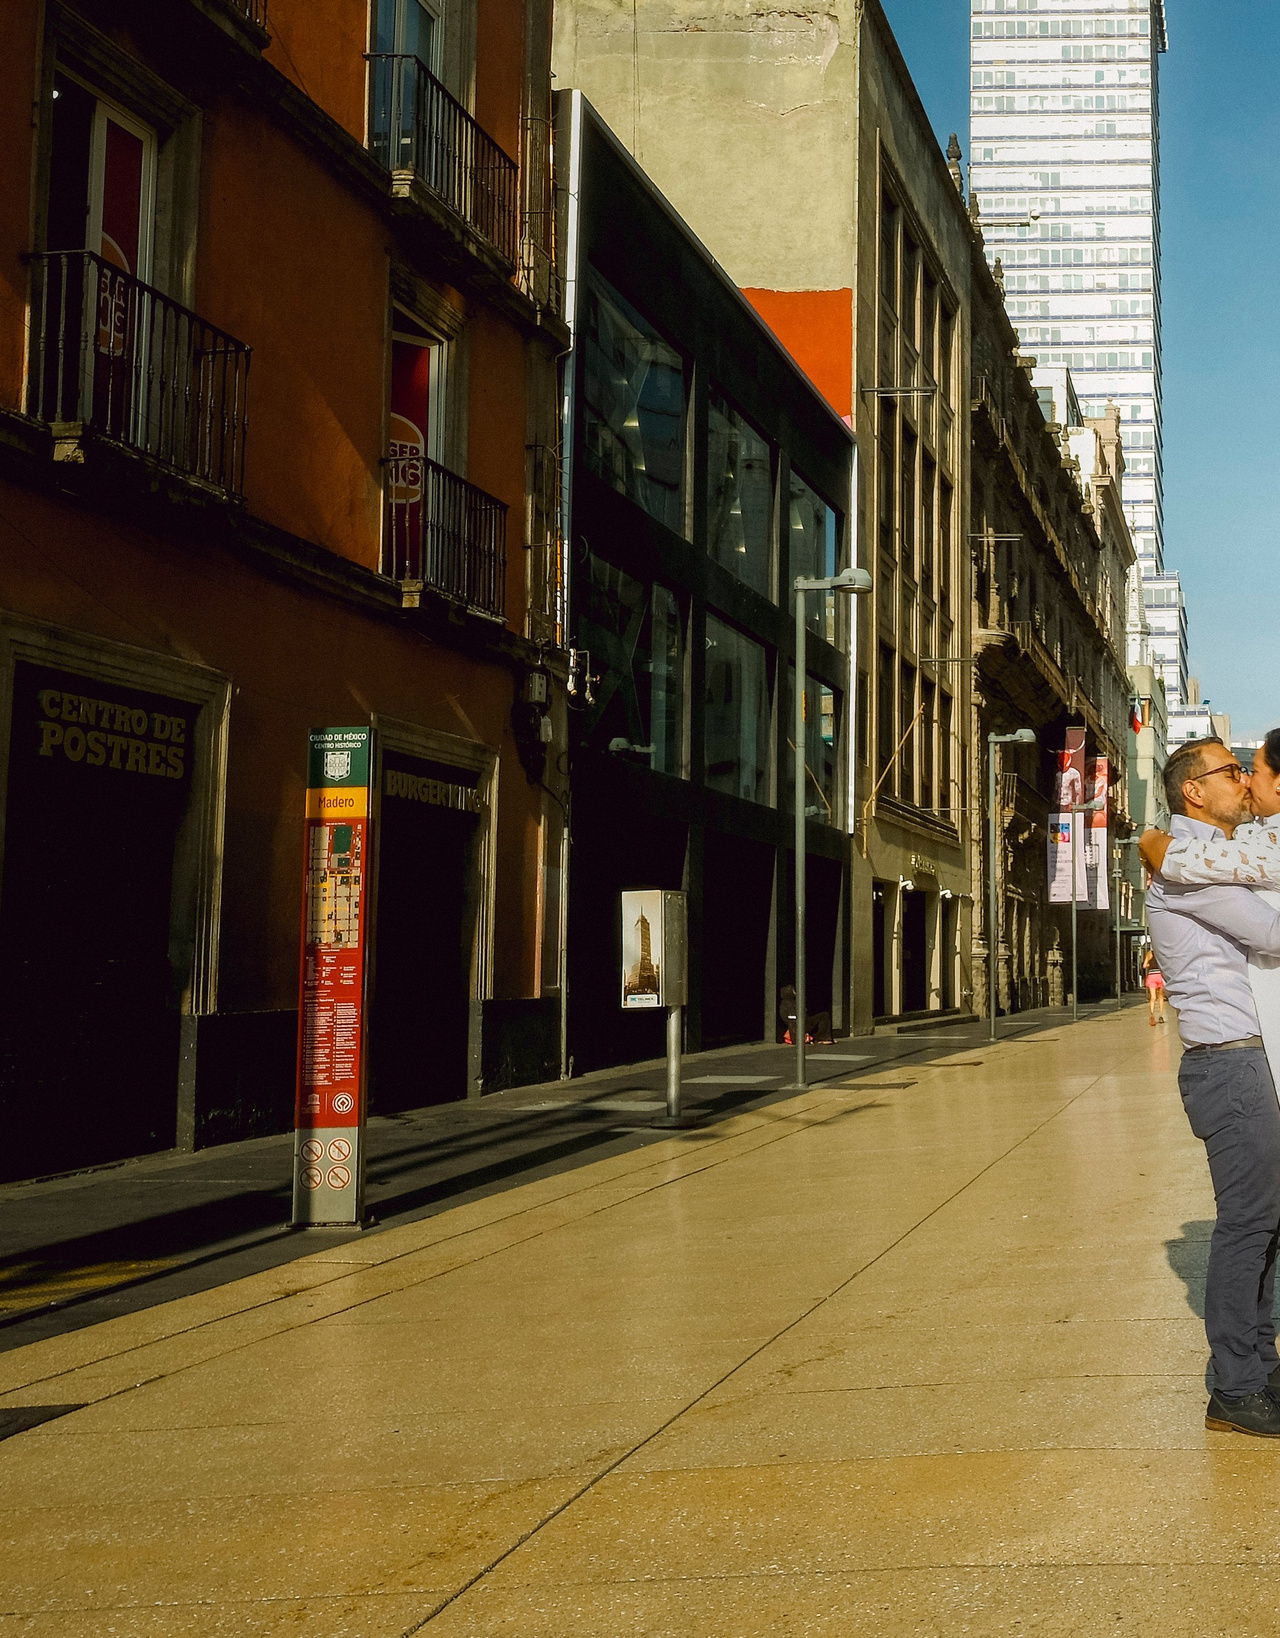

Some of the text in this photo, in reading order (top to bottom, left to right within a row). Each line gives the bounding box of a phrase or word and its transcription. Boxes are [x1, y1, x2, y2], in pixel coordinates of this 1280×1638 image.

[38, 689, 186, 744] CENTRO DE
[309, 732, 367, 742] CIUDAD DE MÉXICO
[314, 741, 362, 750] CENTRO HISTÓRICO
[36, 720, 185, 780] POSTRES
[382, 769, 447, 807] BURGER
[318, 796, 355, 809] Madero
